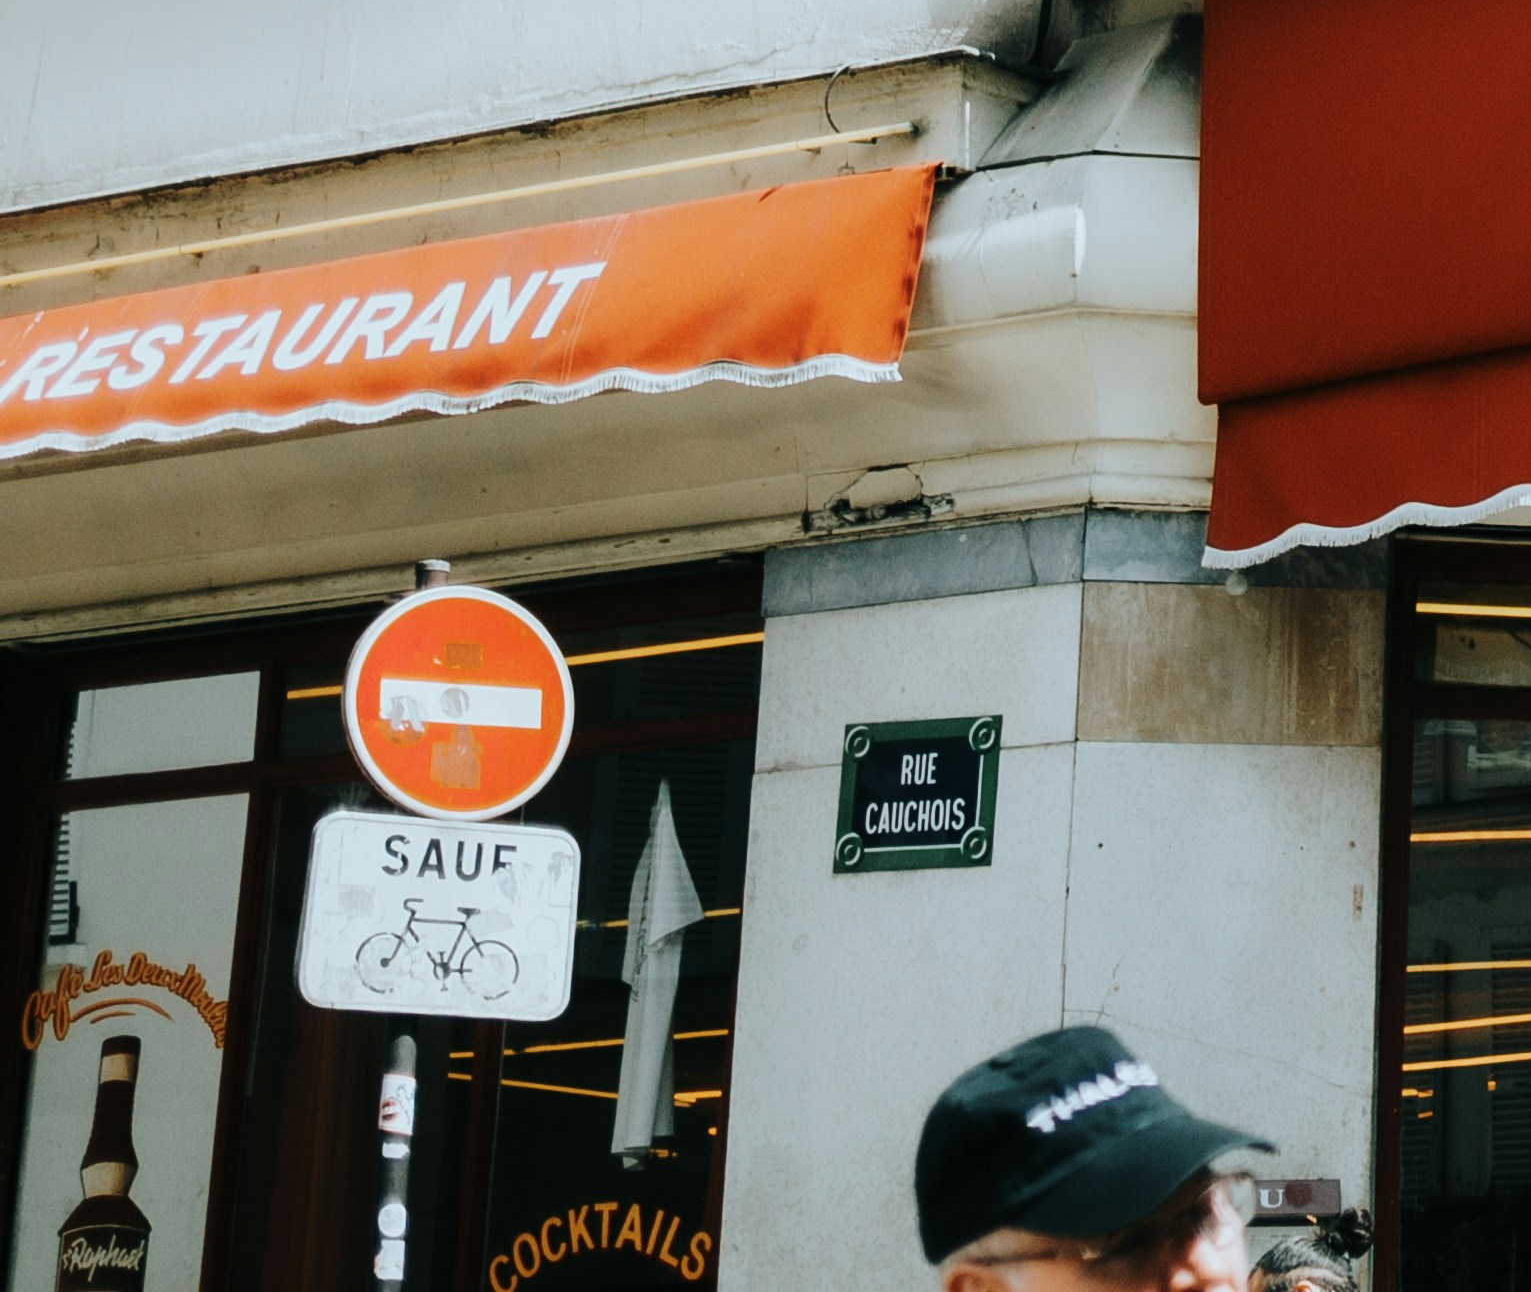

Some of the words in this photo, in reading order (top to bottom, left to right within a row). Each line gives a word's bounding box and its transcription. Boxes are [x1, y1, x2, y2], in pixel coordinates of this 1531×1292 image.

[0, 261, 607, 403] RESTAURANT
[900, 752, 939, 785] RUE
[865, 797, 966, 835] CAUCHOIS
[381, 834, 518, 882] SAUF
[21, 962, 84, 1050] Café
[83, 948, 124, 993] Les
[124, 950, 184, 991] Deux
[489, 1201, 713, 1292] COCKTAILS
